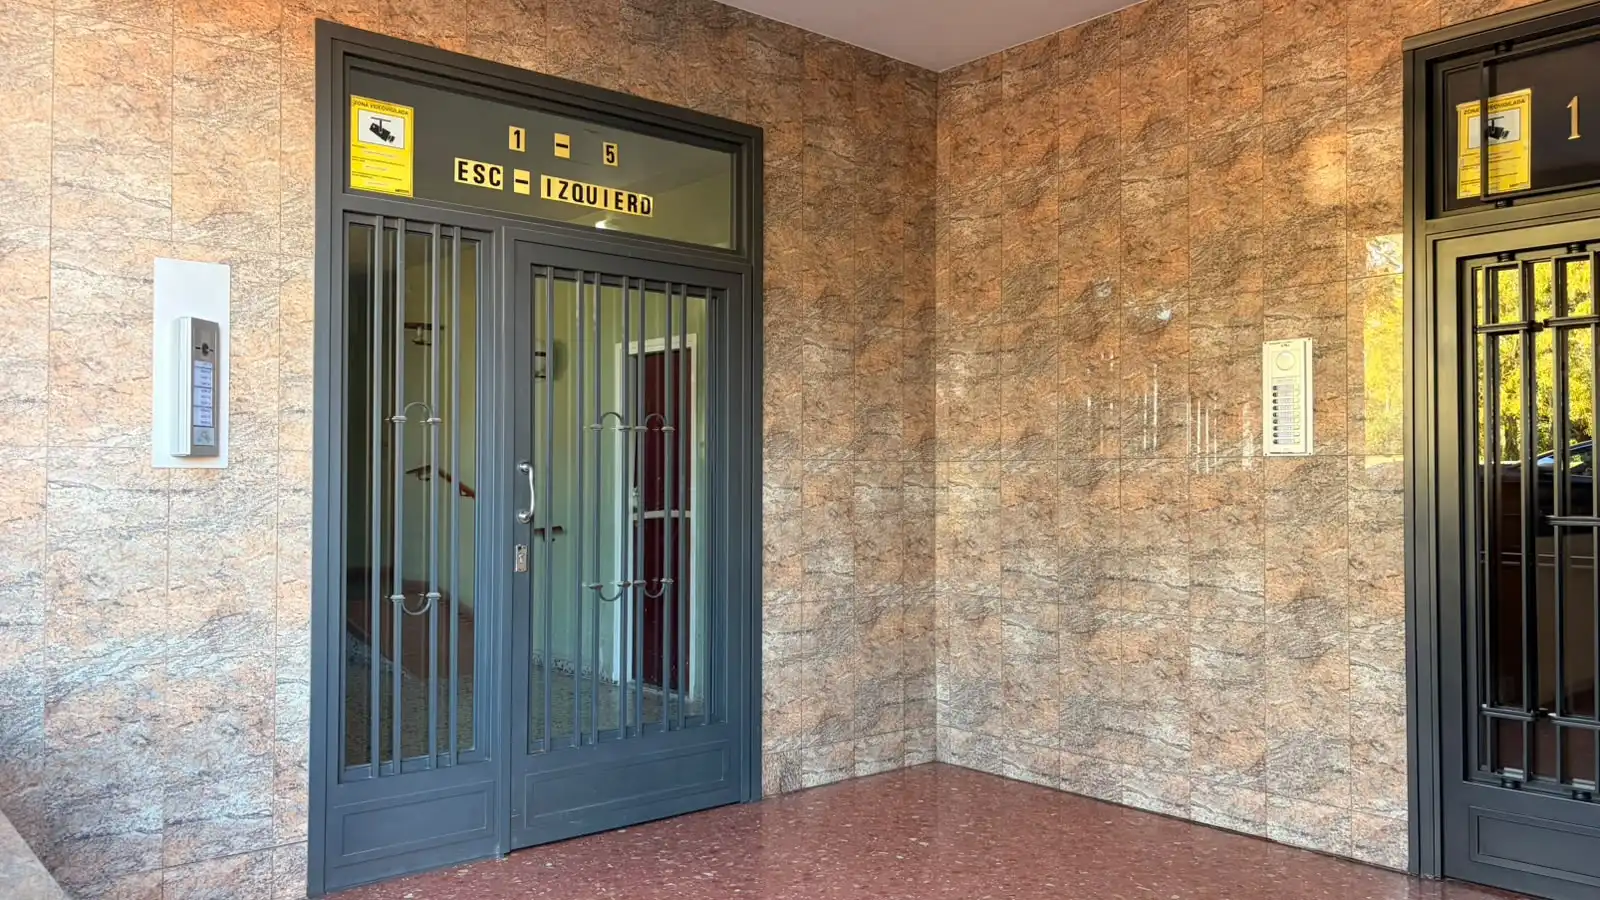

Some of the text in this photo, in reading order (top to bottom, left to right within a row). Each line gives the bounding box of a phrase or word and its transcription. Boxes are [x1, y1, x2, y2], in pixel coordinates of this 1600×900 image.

[353, 99, 409, 116] ZONA VIDEOVIGILADA
[1566, 96, 1581, 140] 1
[513, 130, 521, 149] 1
[605, 145, 615, 164] 5
[458, 160, 501, 187] ESC
[546, 178, 651, 215] IZQUIERD
